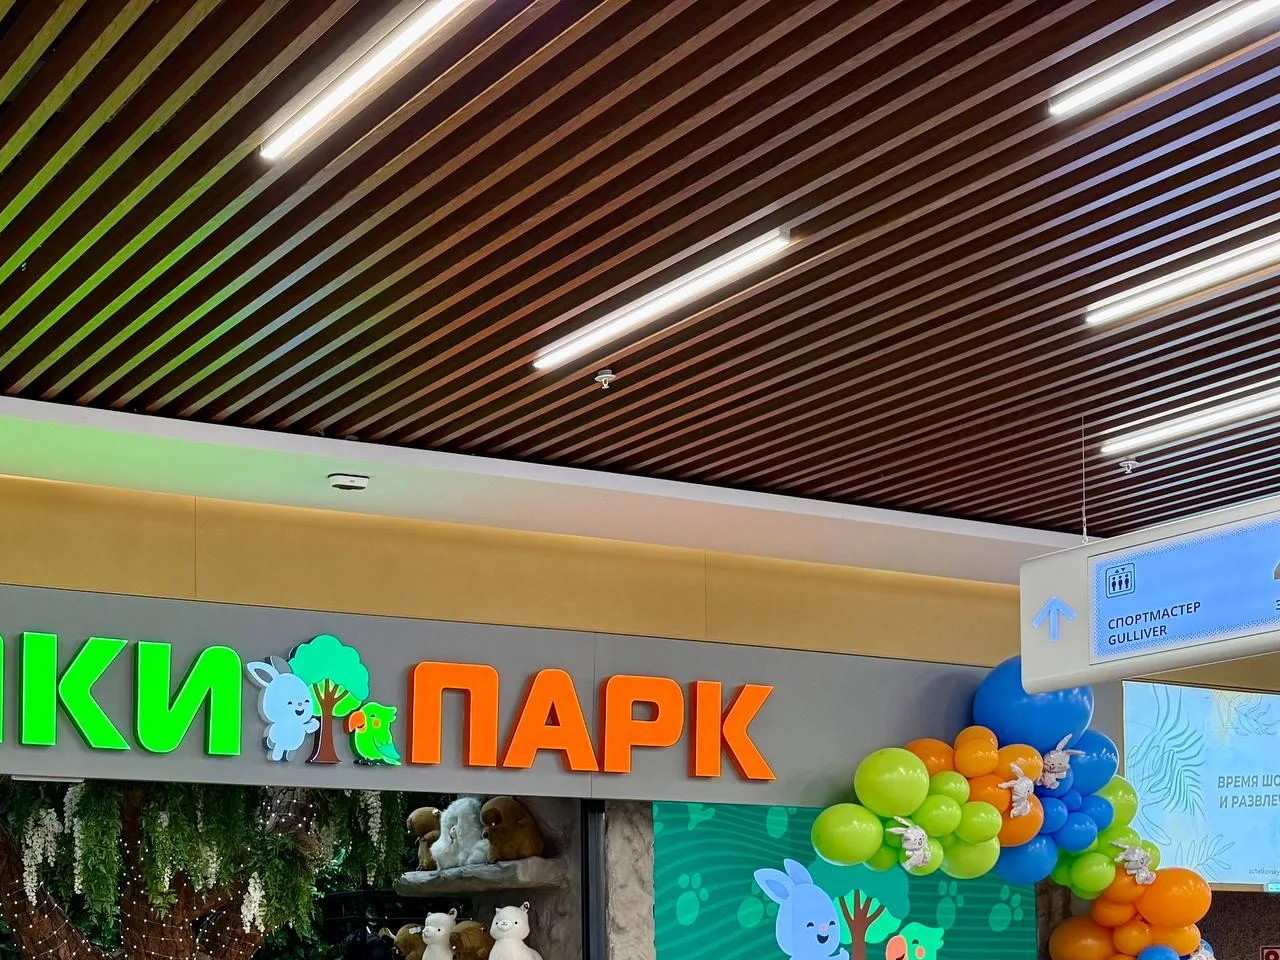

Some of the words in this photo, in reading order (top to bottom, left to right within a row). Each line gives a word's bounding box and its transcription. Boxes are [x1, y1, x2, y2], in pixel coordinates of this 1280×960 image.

[1107, 601, 1201, 630] СПОРТМАСТЕР
[1107, 624, 1168, 646] GULLIVER
[409, 661, 777, 782] ПАРК
[1217, 775, 1259, 789] ВРЕМЯ
[1219, 795, 1228, 809] И
[1231, 793, 1280, 808] РАЗВЛЕ
